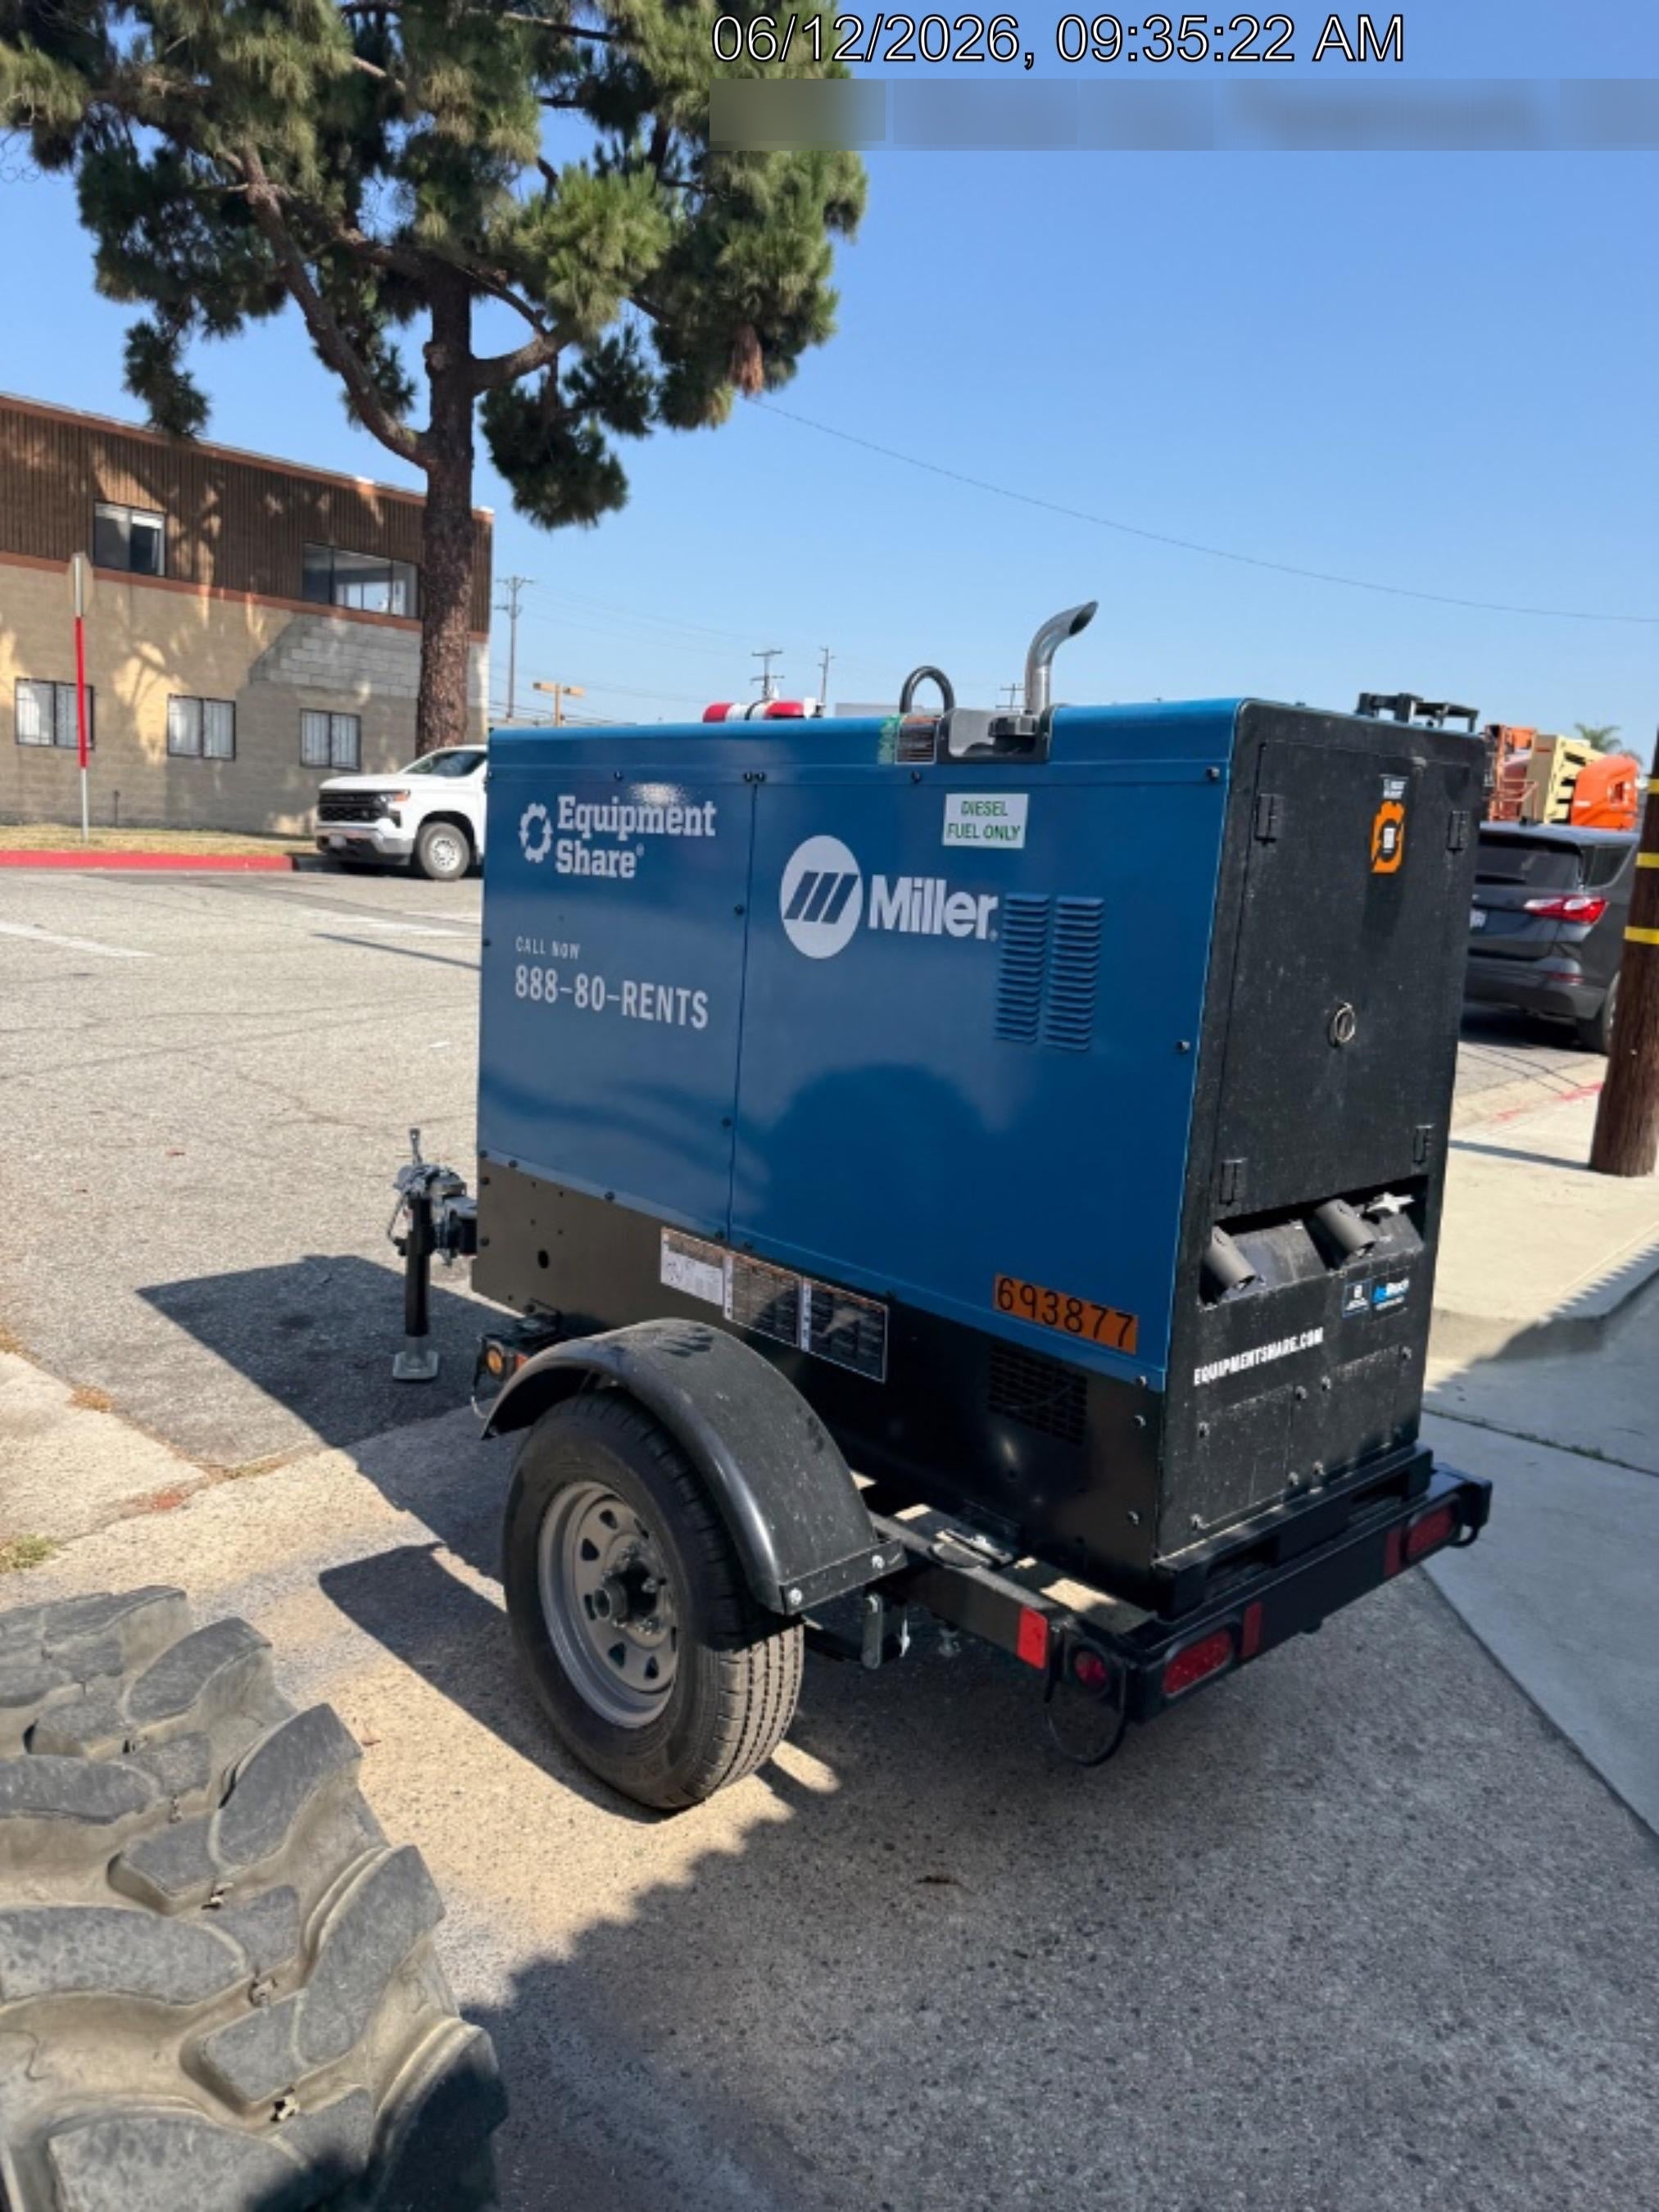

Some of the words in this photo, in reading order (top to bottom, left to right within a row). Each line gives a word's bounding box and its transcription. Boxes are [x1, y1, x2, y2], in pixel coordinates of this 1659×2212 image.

[557, 796, 716, 841] Equipment
[961, 800, 1009, 816] DIESEL
[946, 823, 979, 838] FUEL
[983, 824, 1021, 841] ONLY
[515, 936, 546, 954] CALL
[551, 941, 580, 959] NOW
[514, 964, 709, 1030] 888-80-RENTS
[997, 1277, 1134, 1348] 693877
[1194, 1326, 1324, 1386] EQUIPMENTSHARE.COM
